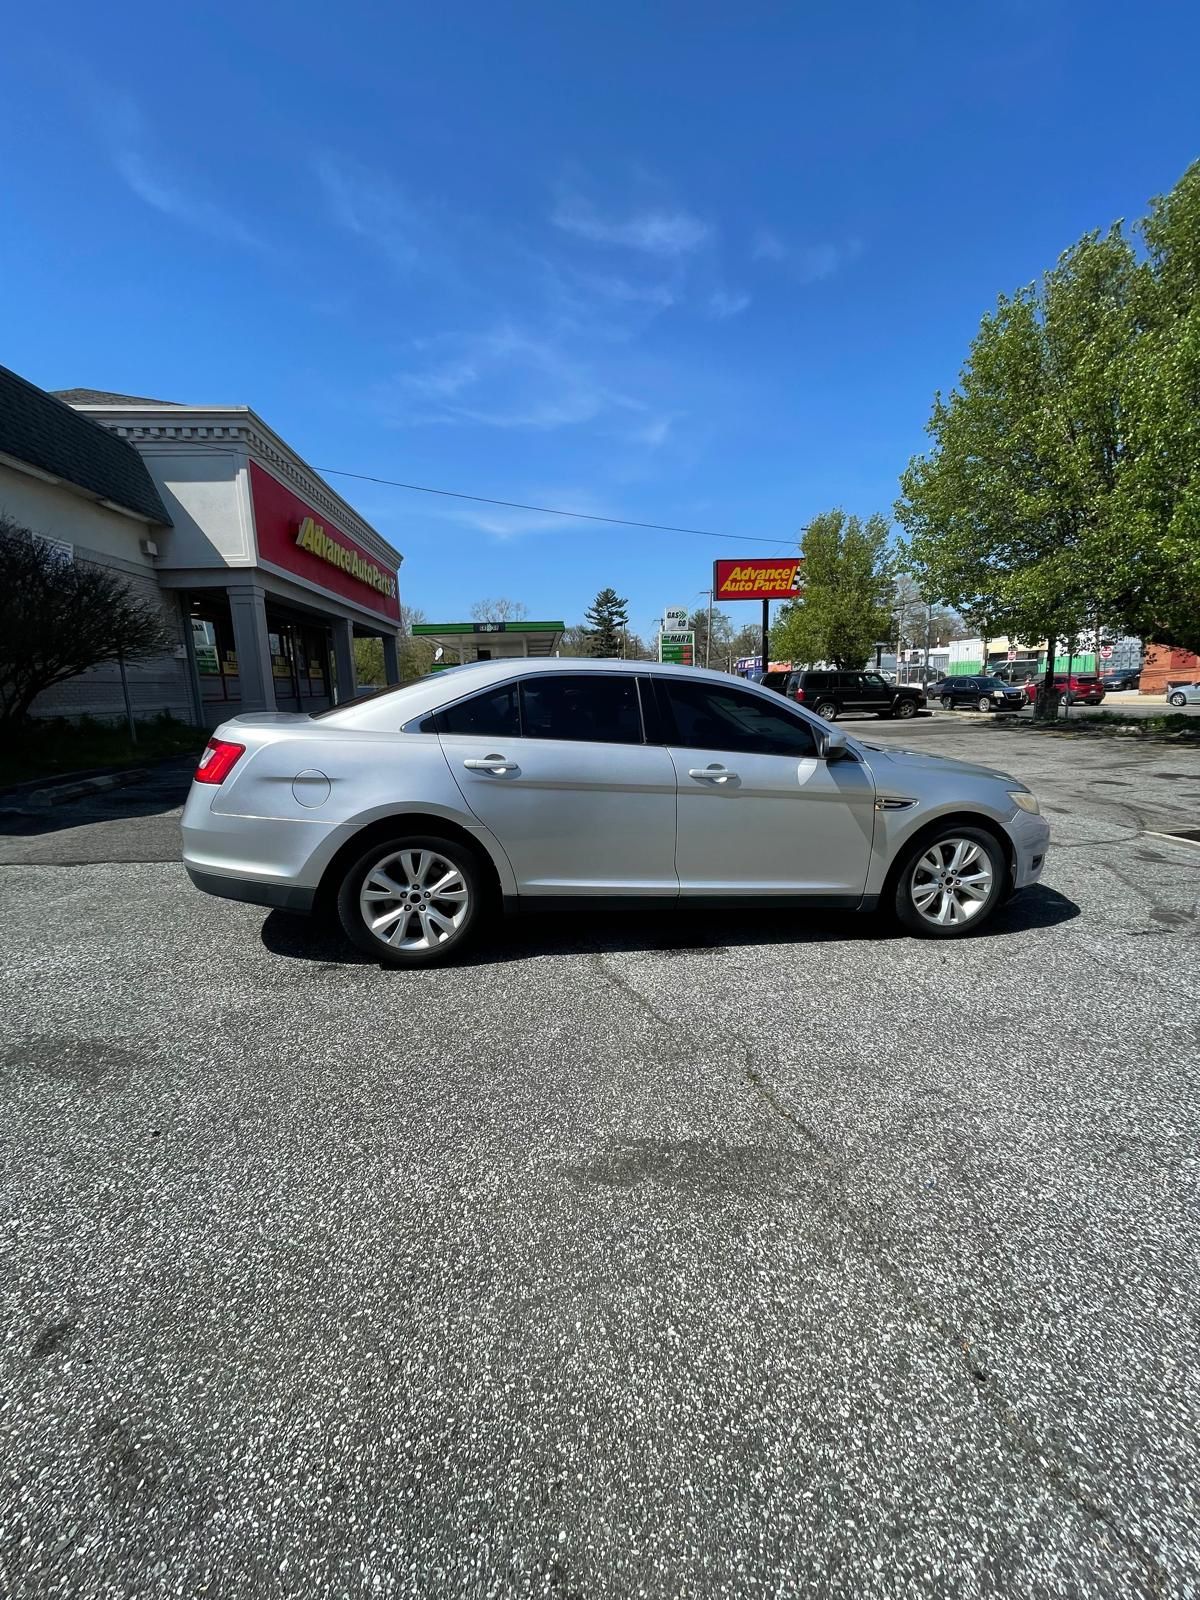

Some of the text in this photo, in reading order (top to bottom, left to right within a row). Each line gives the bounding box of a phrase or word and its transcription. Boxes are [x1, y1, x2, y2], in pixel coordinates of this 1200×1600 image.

[297, 517, 391, 595] Advance Auto Parts
[728, 566, 789, 580] Advance
[720, 580, 787, 591] Auto Parts
[667, 611, 679, 619] GAS
[677, 619, 687, 627] GO
[670, 634, 690, 643] MART
